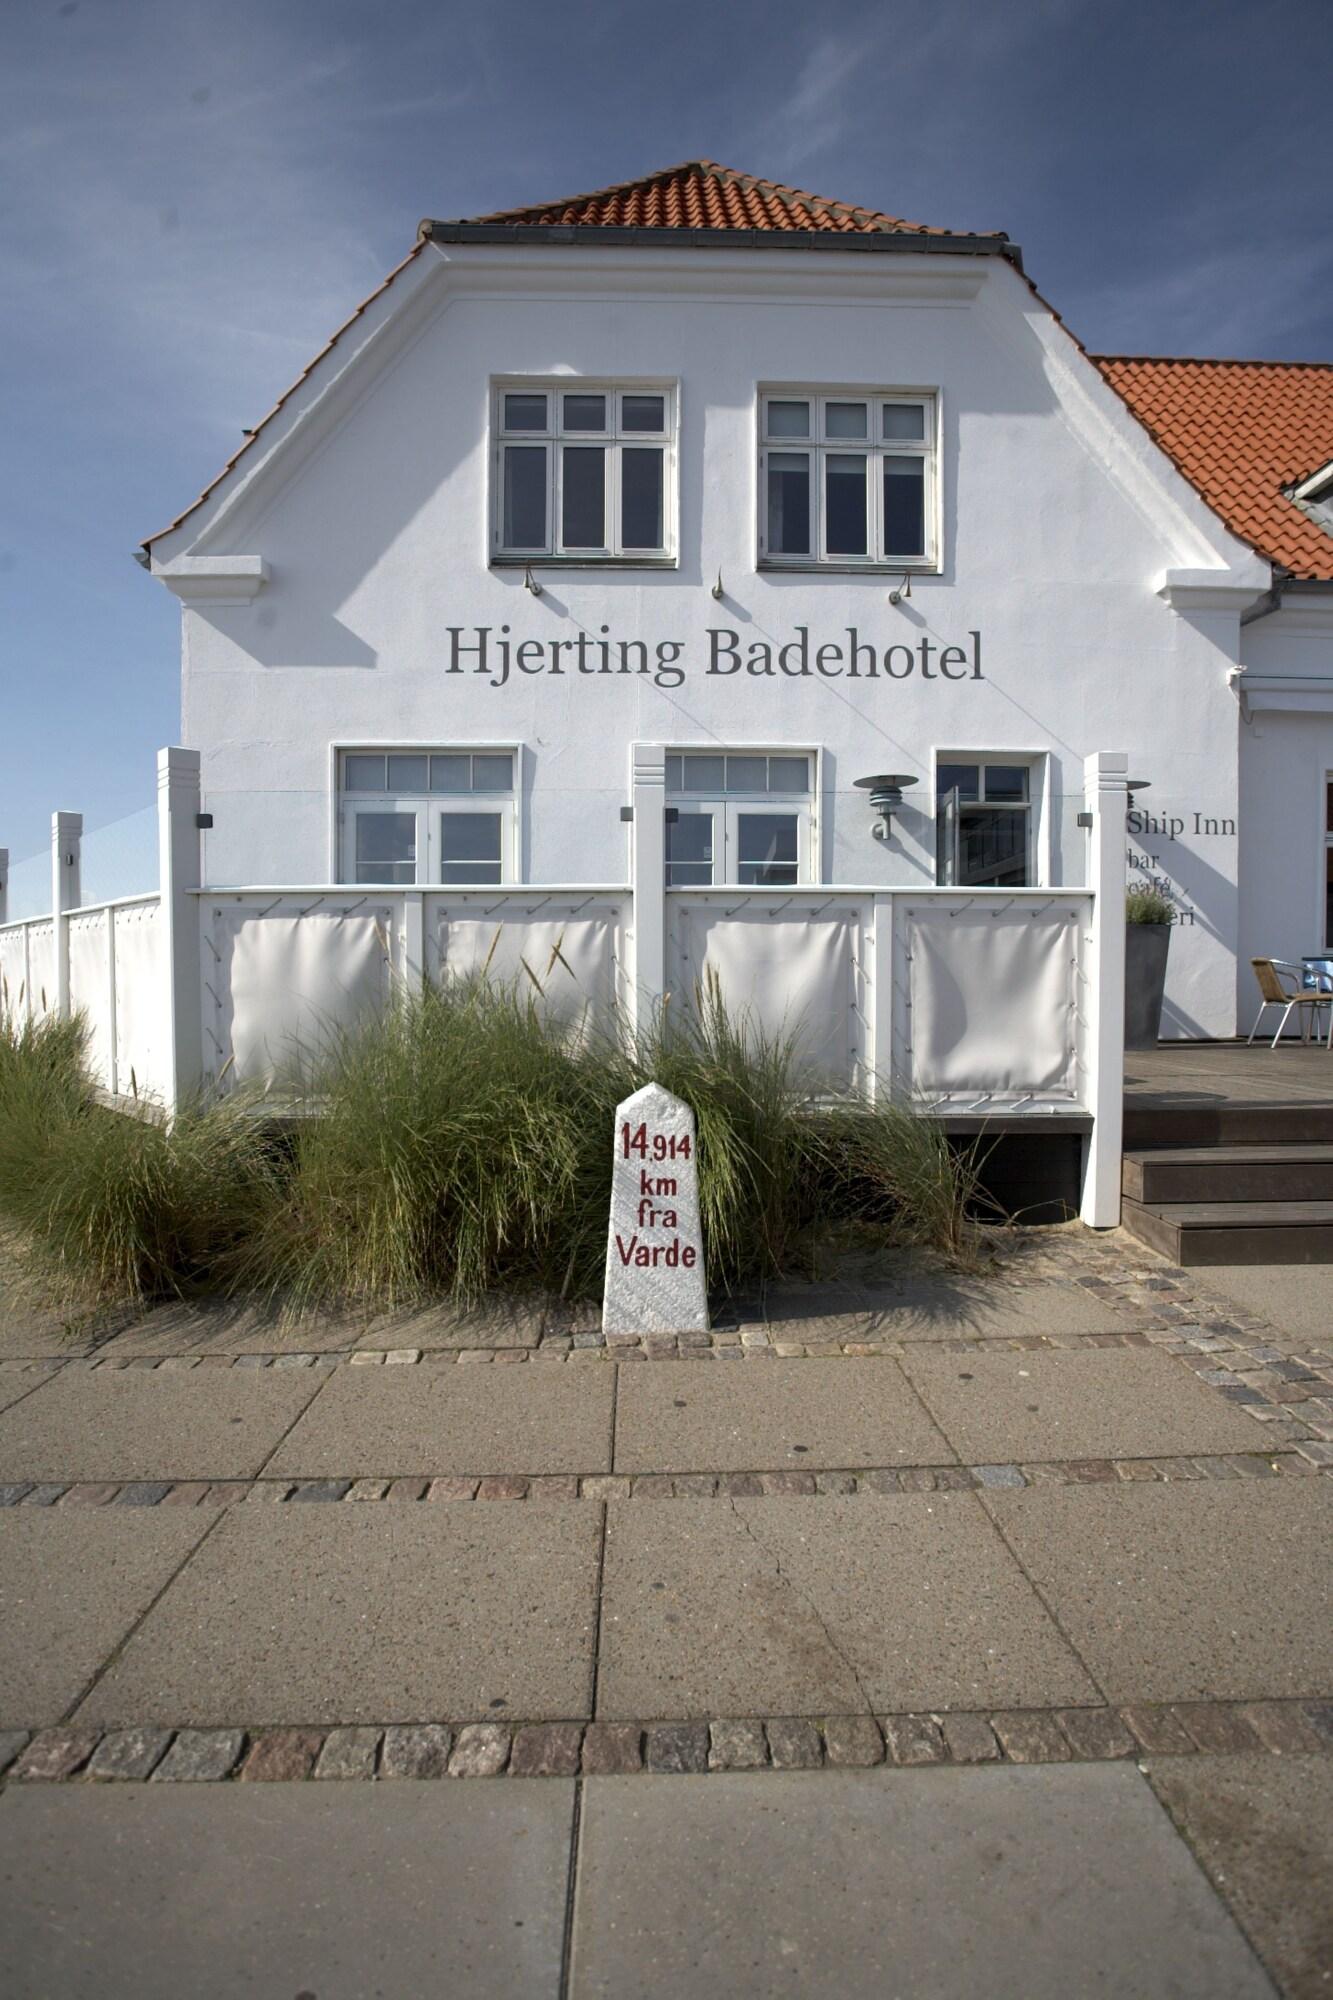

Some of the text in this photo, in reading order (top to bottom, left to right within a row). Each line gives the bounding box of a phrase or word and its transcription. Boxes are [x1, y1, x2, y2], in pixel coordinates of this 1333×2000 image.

[445, 624, 985, 688] Hjerting Badehotel
[1127, 810, 1237, 841] Ship Inn
[1127, 848, 1160, 869] bar
[640, 1169, 678, 1197] km
[637, 1199, 678, 1228] fra
[616, 1234, 697, 1269] Varde
